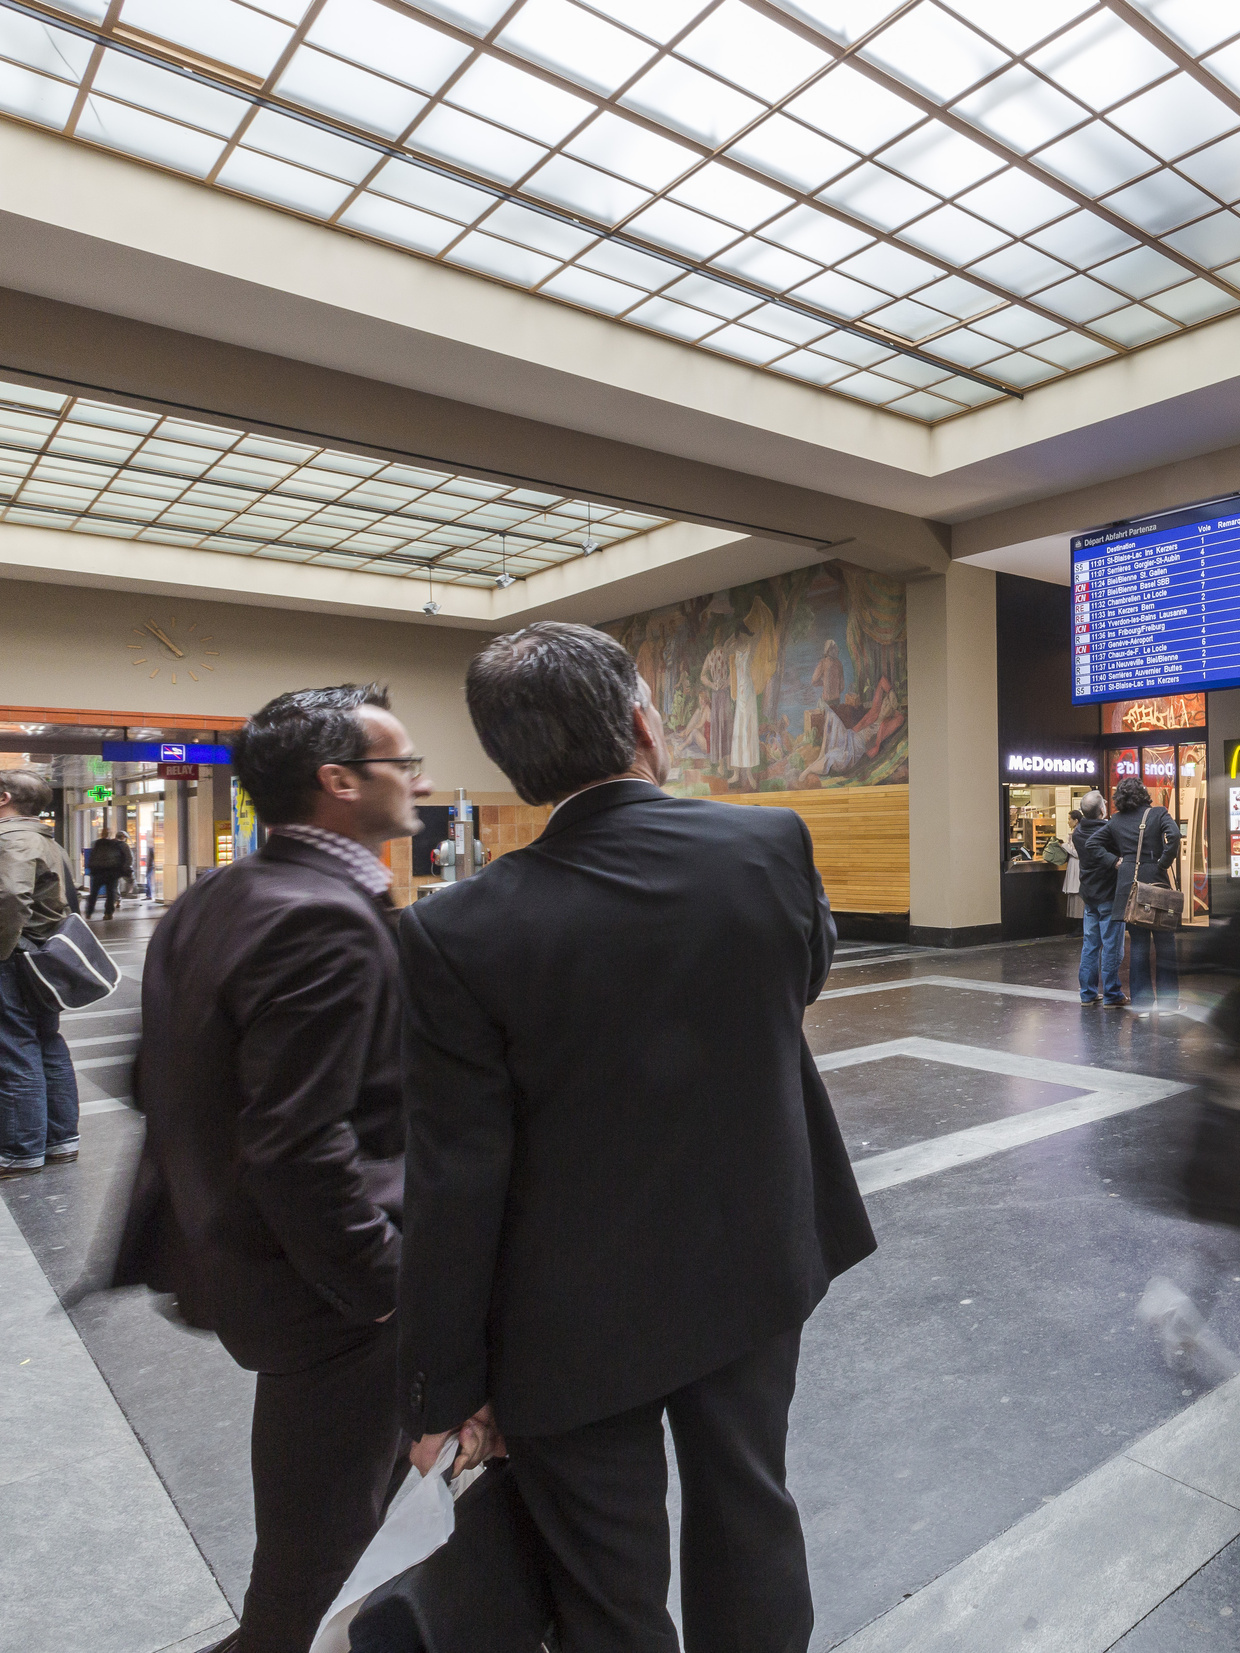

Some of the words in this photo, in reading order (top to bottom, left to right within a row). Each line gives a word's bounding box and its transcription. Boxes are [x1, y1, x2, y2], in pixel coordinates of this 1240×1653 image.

[1085, 536, 1104, 546] Départ
[1105, 530, 1127, 542] Abfahrt
[1129, 525, 1156, 536] Partenza
[1107, 543, 1135, 553] Destination
[1198, 525, 1211, 533] Voie
[1076, 564, 1083, 572] S5
[1091, 559, 1104, 568] 11:01
[1107, 551, 1142, 564] St-Blaise-Lac
[1145, 548, 1153, 556] Ins
[1156, 544, 1178, 554] Kerzers
[1075, 583, 1086, 592] ICN
[1091, 579, 1105, 588] 11:24
[1107, 574, 1137, 586] Biel/Bienne
[1149, 568, 1167, 577] Gallen
[1091, 569, 1105, 578] 11:07
[1075, 593, 1086, 603] ICN
[1091, 590, 1105, 598] 11:27
[1107, 584, 1137, 596] Biel/Bienne
[1140, 580, 1156, 589] Basel
[1157, 578, 1169, 586] SBB
[1076, 605, 1084, 613] RE
[1091, 600, 1105, 609] 11:32
[1152, 590, 1167, 598] Locle
[1075, 625, 1086, 633] ICN
[1092, 621, 1106, 630] 11:34
[1108, 613, 1156, 627] Yverdon-les-Bains
[1159, 608, 1187, 618] Lausanne
[1076, 615, 1084, 623] RE
[1092, 611, 1105, 619] 11:33
[1118, 606, 1138, 615] Kerzers
[1141, 603, 1154, 611] Bern
[1118, 623, 1165, 636] Fribourg/Freiburg
[1202, 615, 1205, 623] 1
[1076, 646, 1086, 654] ICN
[1092, 642, 1106, 651] 11:37
[1092, 652, 1106, 661] 11:37
[1108, 648, 1140, 658] Chaux-de-F.
[1152, 644, 1167, 652] Locle
[1092, 663, 1106, 671] 11:37
[1116, 658, 1144, 668] Neuveville
[1147, 654, 1178, 664] Biel/Bienne
[1202, 649, 1206, 657] 2
[1092, 674, 1106, 682] 11:40
[1135, 667, 1161, 676] Auvernier
[1164, 664, 1182, 673] Buttes
[1092, 684, 1106, 692] 12:01
[1109, 679, 1143, 690] St-Blaise-Lac
[1158, 676, 1179, 685] Kerzers
[166, 766, 193, 775] RELAY
[1009, 755, 1095, 773] McDonald's
